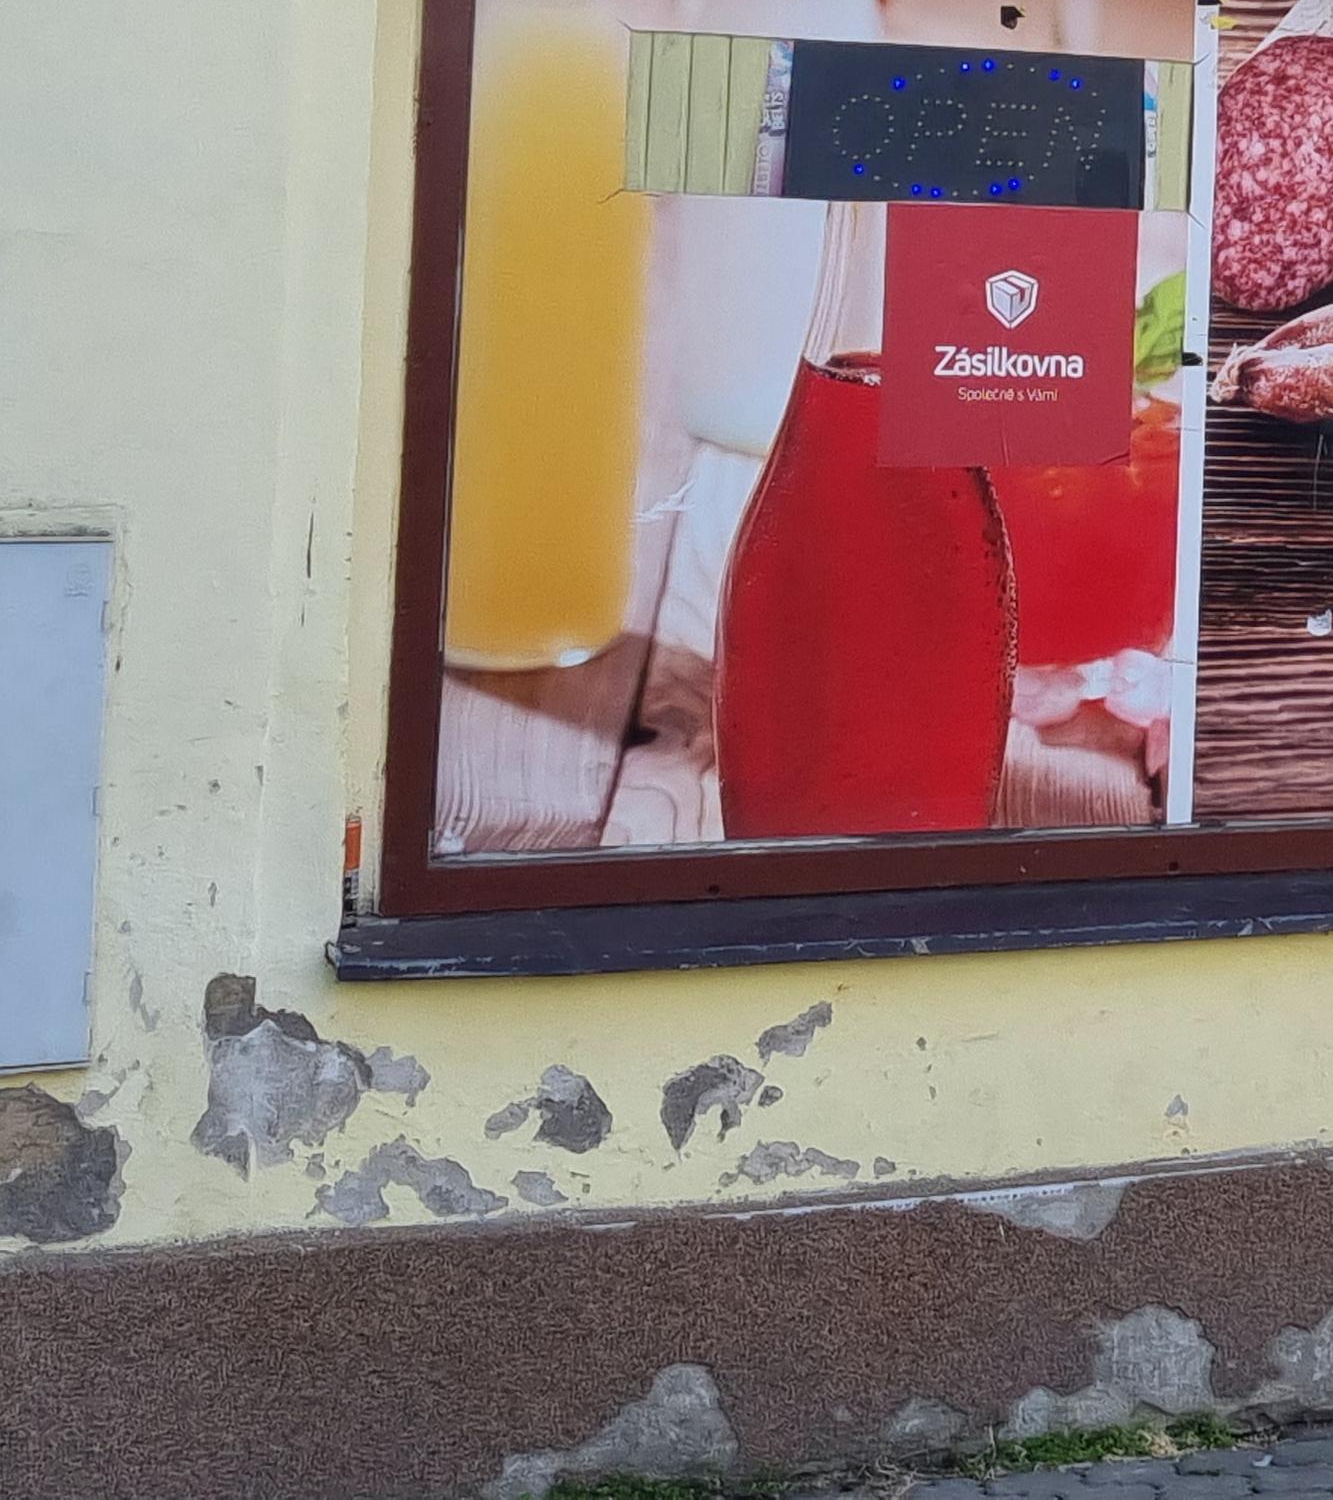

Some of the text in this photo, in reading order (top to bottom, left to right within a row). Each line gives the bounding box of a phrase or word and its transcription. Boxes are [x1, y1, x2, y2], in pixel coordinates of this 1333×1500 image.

[832, 94, 1106, 171] OPEN
[933, 345, 1084, 378] Zásilkovna
[957, 386, 1058, 402] Společně s Vámi
